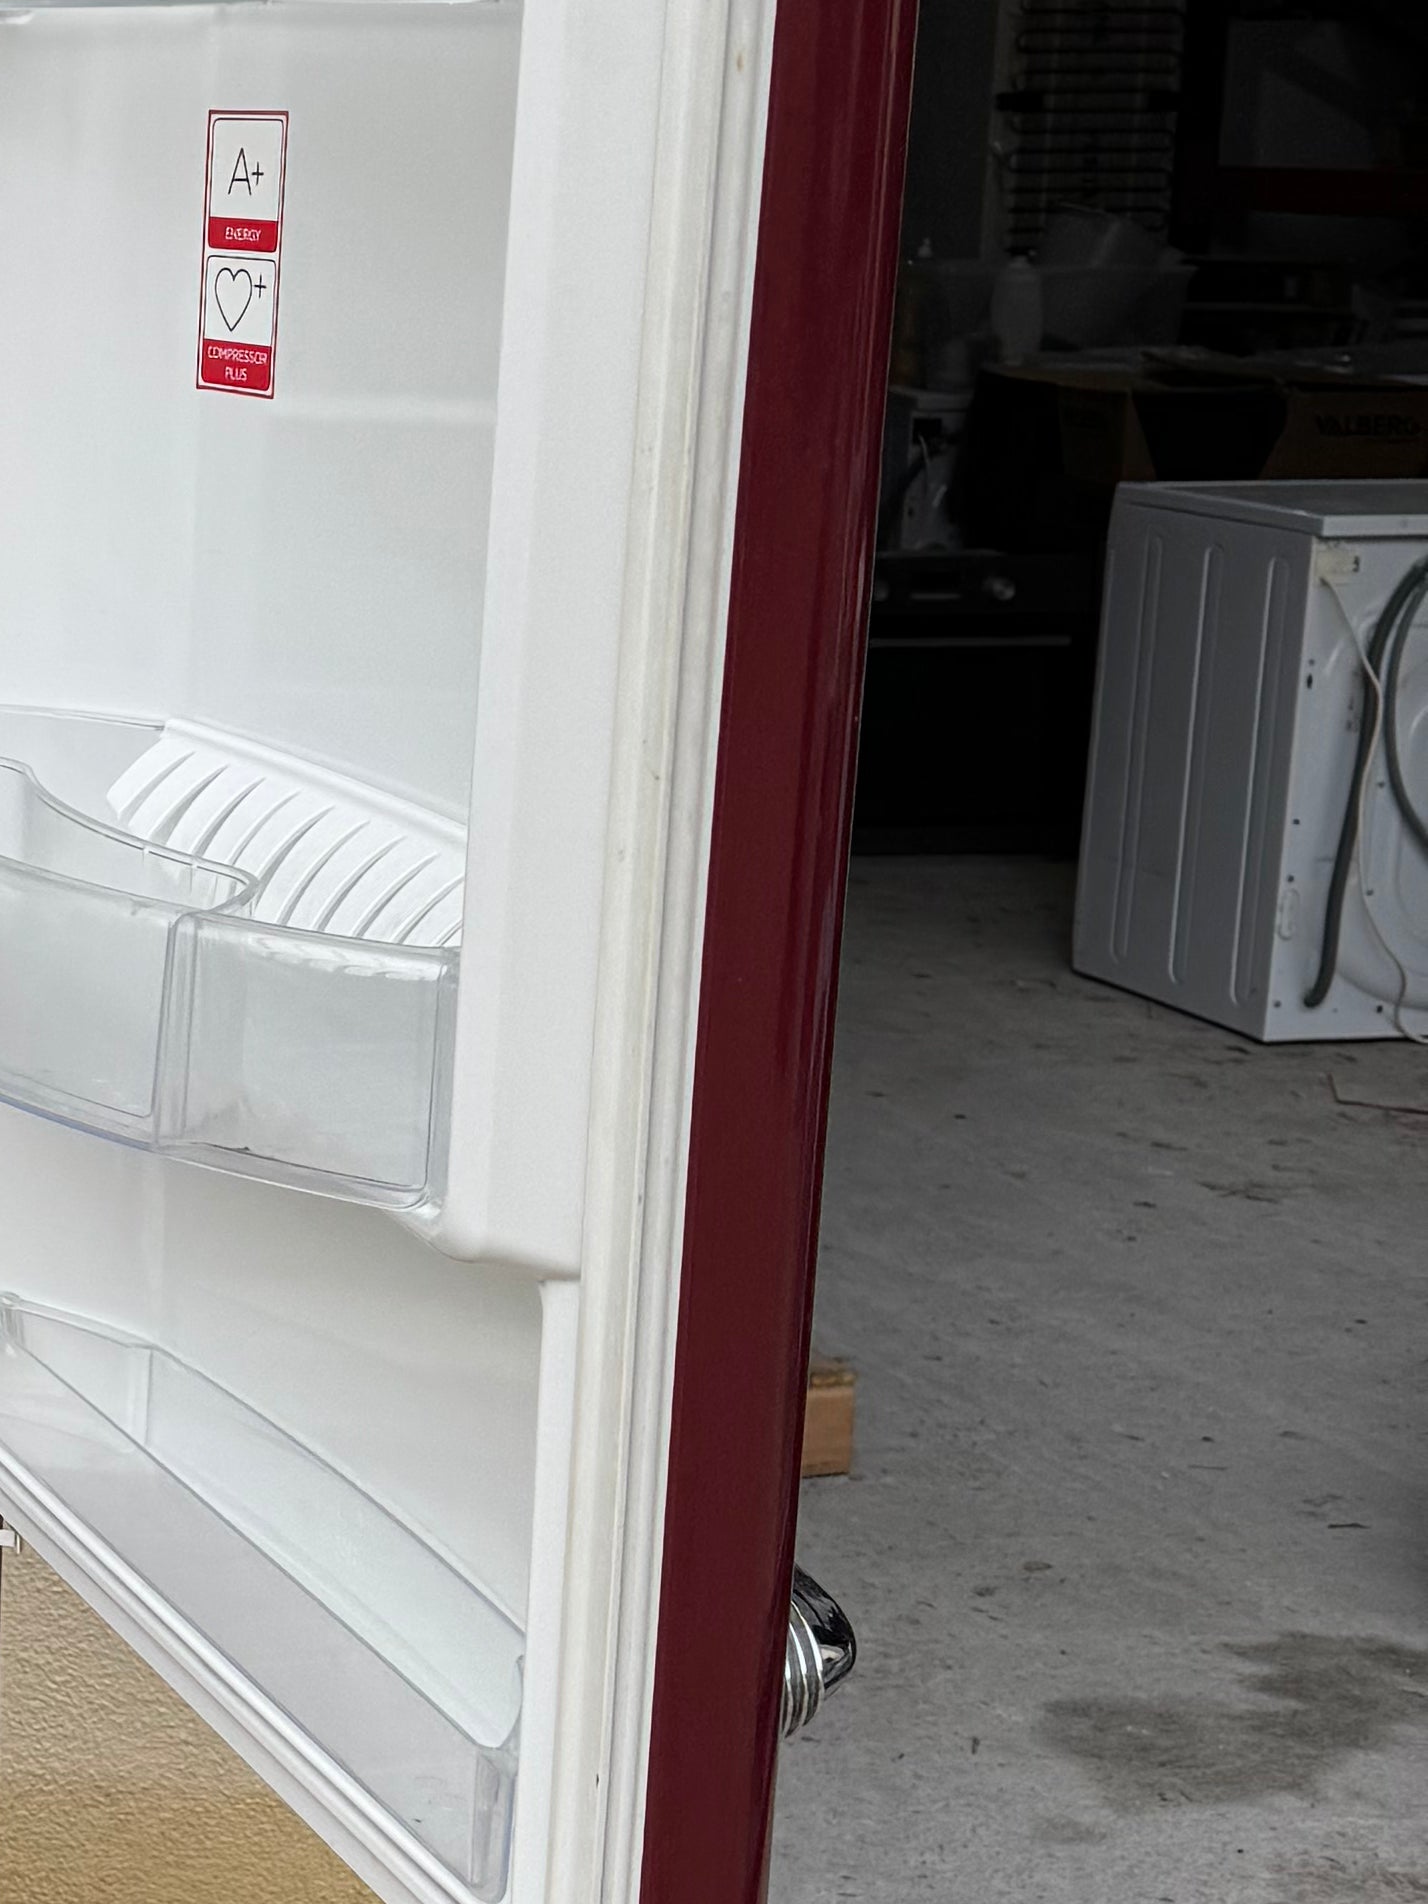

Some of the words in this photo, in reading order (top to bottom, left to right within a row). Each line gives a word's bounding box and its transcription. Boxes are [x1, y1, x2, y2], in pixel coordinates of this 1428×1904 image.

[227, 147, 265, 196] A+
[225, 226, 262, 242] ENERGY
[207, 345, 268, 365] COMPRESSOR
[225, 366, 248, 382] PLUS
